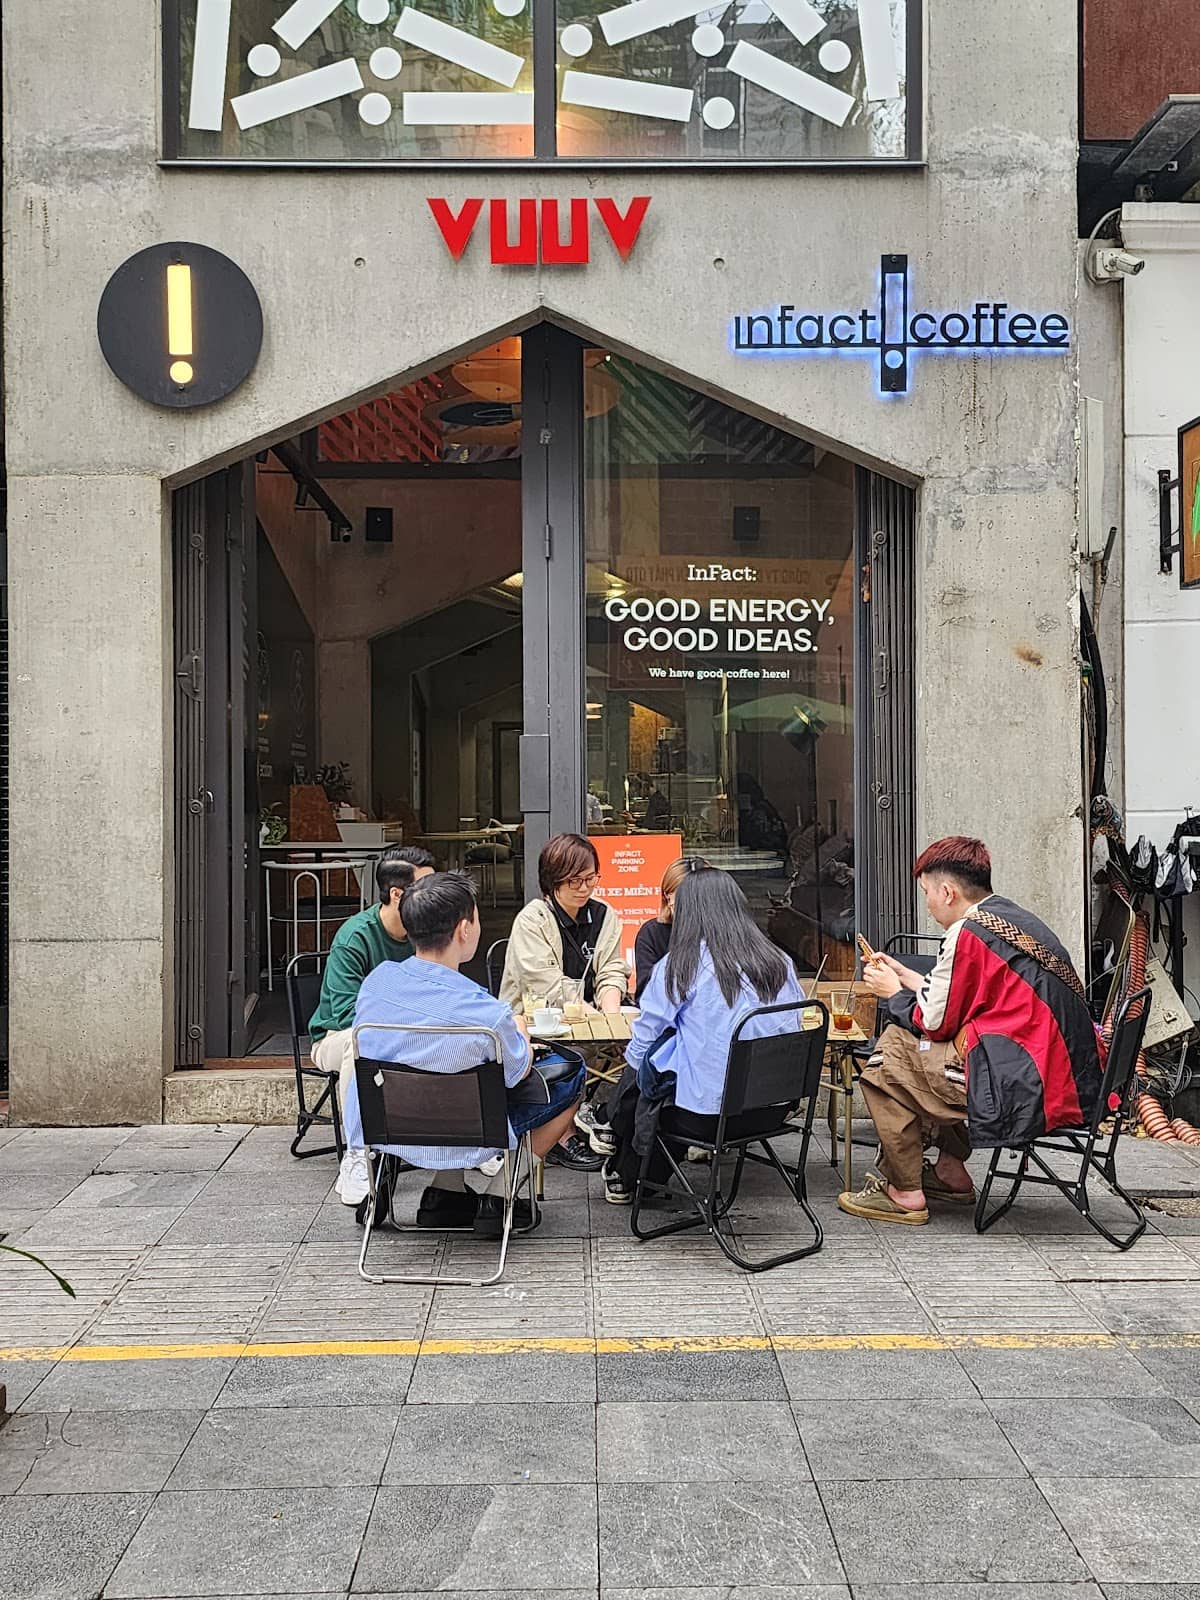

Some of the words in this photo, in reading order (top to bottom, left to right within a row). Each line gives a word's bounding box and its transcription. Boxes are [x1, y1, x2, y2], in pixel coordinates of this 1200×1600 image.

[427, 196, 652, 265] VUUV
[687, 564, 757, 581] InFact:
[605, 598, 700, 622] GOOD
[709, 598, 834, 625] ENERGY,
[623, 627, 719, 651] GOOD
[728, 628, 818, 651] IDEAS.
[648, 668, 667, 677] We
[669, 668, 694, 678] have
[697, 669, 723, 680] good
[726, 669, 760, 678] coffee
[762, 669, 790, 679] here!
[607, 887, 622, 896] XE
